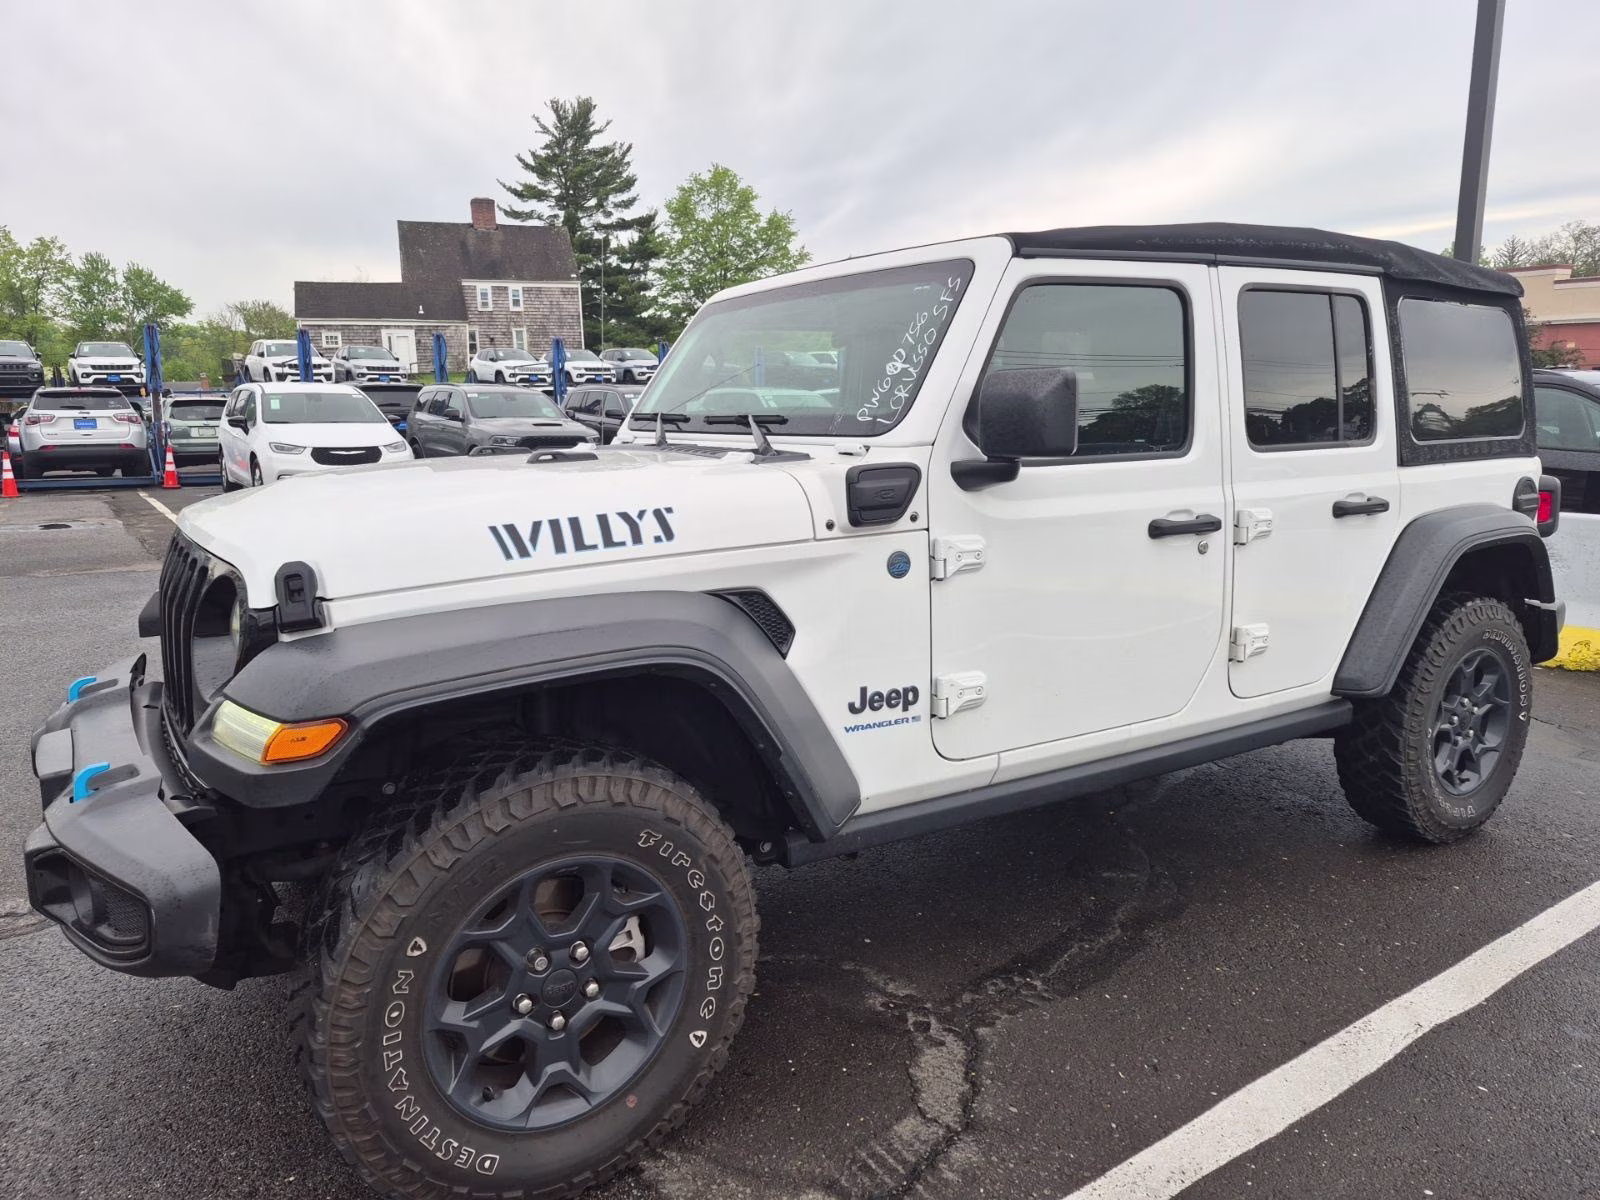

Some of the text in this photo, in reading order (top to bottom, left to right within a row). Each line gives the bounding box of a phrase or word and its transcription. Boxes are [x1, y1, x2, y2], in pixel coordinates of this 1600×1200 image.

[488, 507, 675, 561] WILLYS
[847, 685, 920, 715] Jeep
[1482, 629, 1528, 706] DESTINATION
[844, 717, 910, 733] WRANGLER
[636, 829, 725, 1020] Firestone
[383, 969, 500, 1176] DESTINATION
